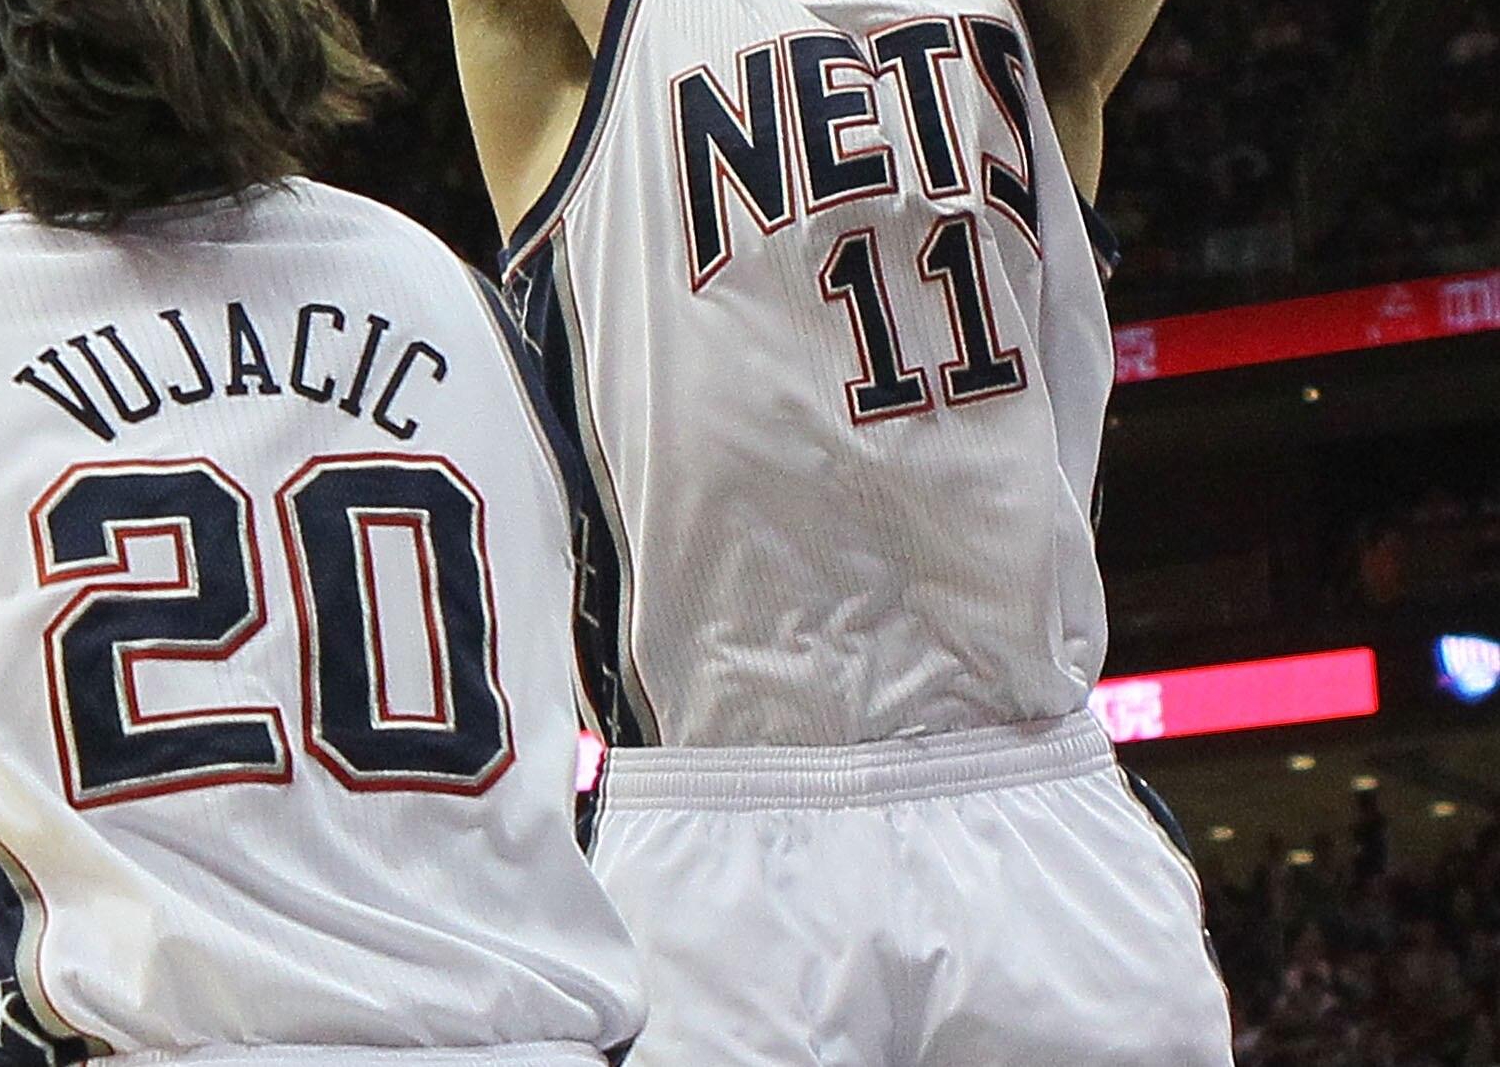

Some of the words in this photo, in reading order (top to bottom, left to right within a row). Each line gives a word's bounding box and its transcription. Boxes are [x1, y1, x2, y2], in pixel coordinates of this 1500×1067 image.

[670, 14, 1042, 293] NETS
[13, 301, 448, 443] VUJACIC
[819, 211, 1027, 426] 11
[28, 452, 516, 810] 20
